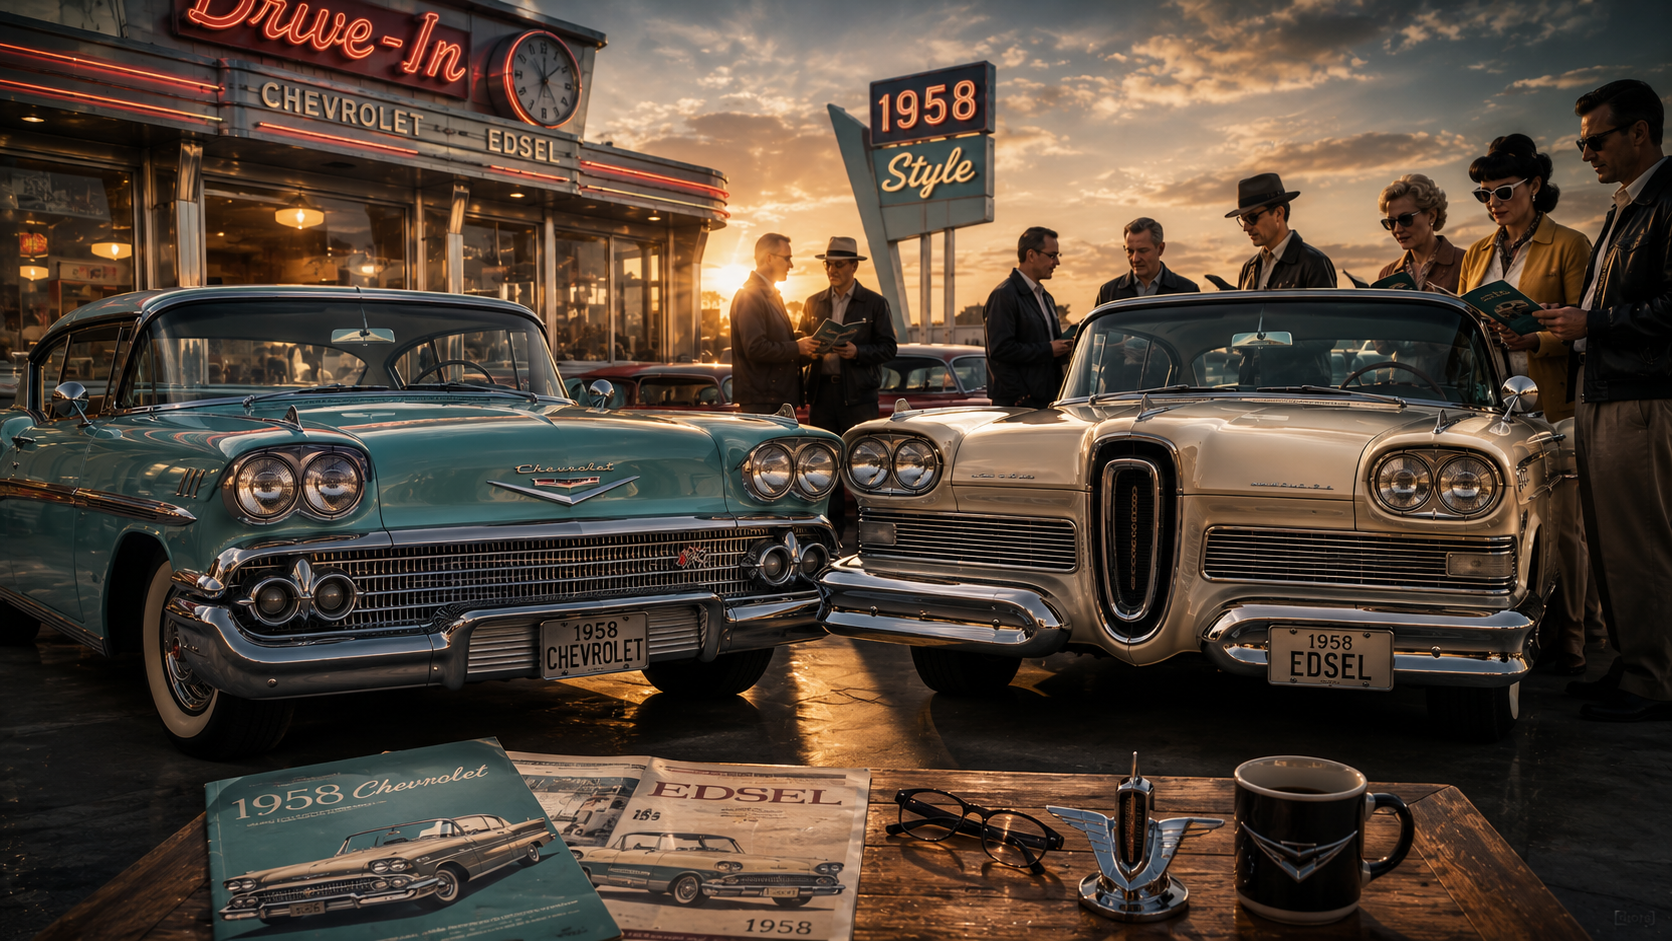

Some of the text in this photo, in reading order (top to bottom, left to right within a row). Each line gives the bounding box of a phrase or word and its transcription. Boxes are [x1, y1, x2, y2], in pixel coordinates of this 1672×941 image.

[878, 80, 977, 132] 1958
[261, 81, 560, 163] CHEVROLET EDSEL
[881, 147, 976, 199] Style
[573, 620, 618, 641] 1958
[1308, 634, 1353, 650] 1958
[547, 638, 643, 670] CHEVROLET
[1290, 651, 1372, 681] EDSEL
[232, 784, 345, 820] 1958
[352, 763, 489, 799] Chevrolet
[648, 780, 842, 806] EDSEL
[745, 918, 812, 935] 1958
